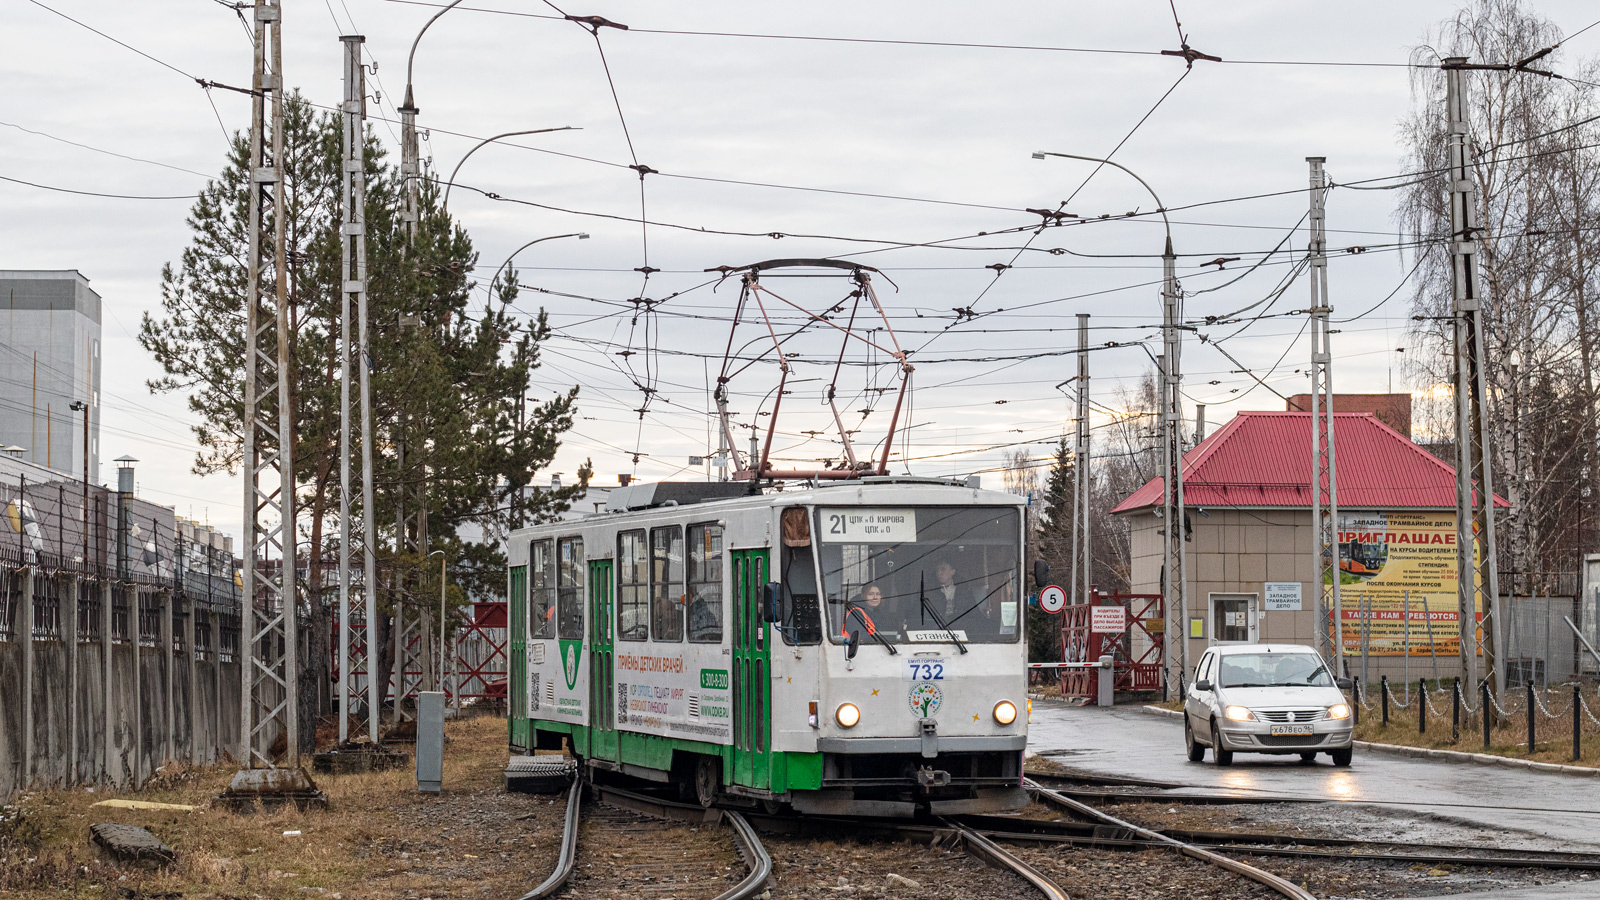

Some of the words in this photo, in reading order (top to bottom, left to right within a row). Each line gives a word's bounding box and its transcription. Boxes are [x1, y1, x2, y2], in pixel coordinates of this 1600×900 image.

[830, 514, 846, 534] 21
[849, 516, 863, 524] ЦПК
[1050, 594, 1056, 604] 5
[618, 652, 639, 670] ПРИЁМЫ
[640, 656, 662, 673] ДЕТСКИХ
[663, 654, 683, 673] ВРАЧЕЙ
[910, 664, 944, 680] 732
[706, 673, 727, 687] 300-8-300
